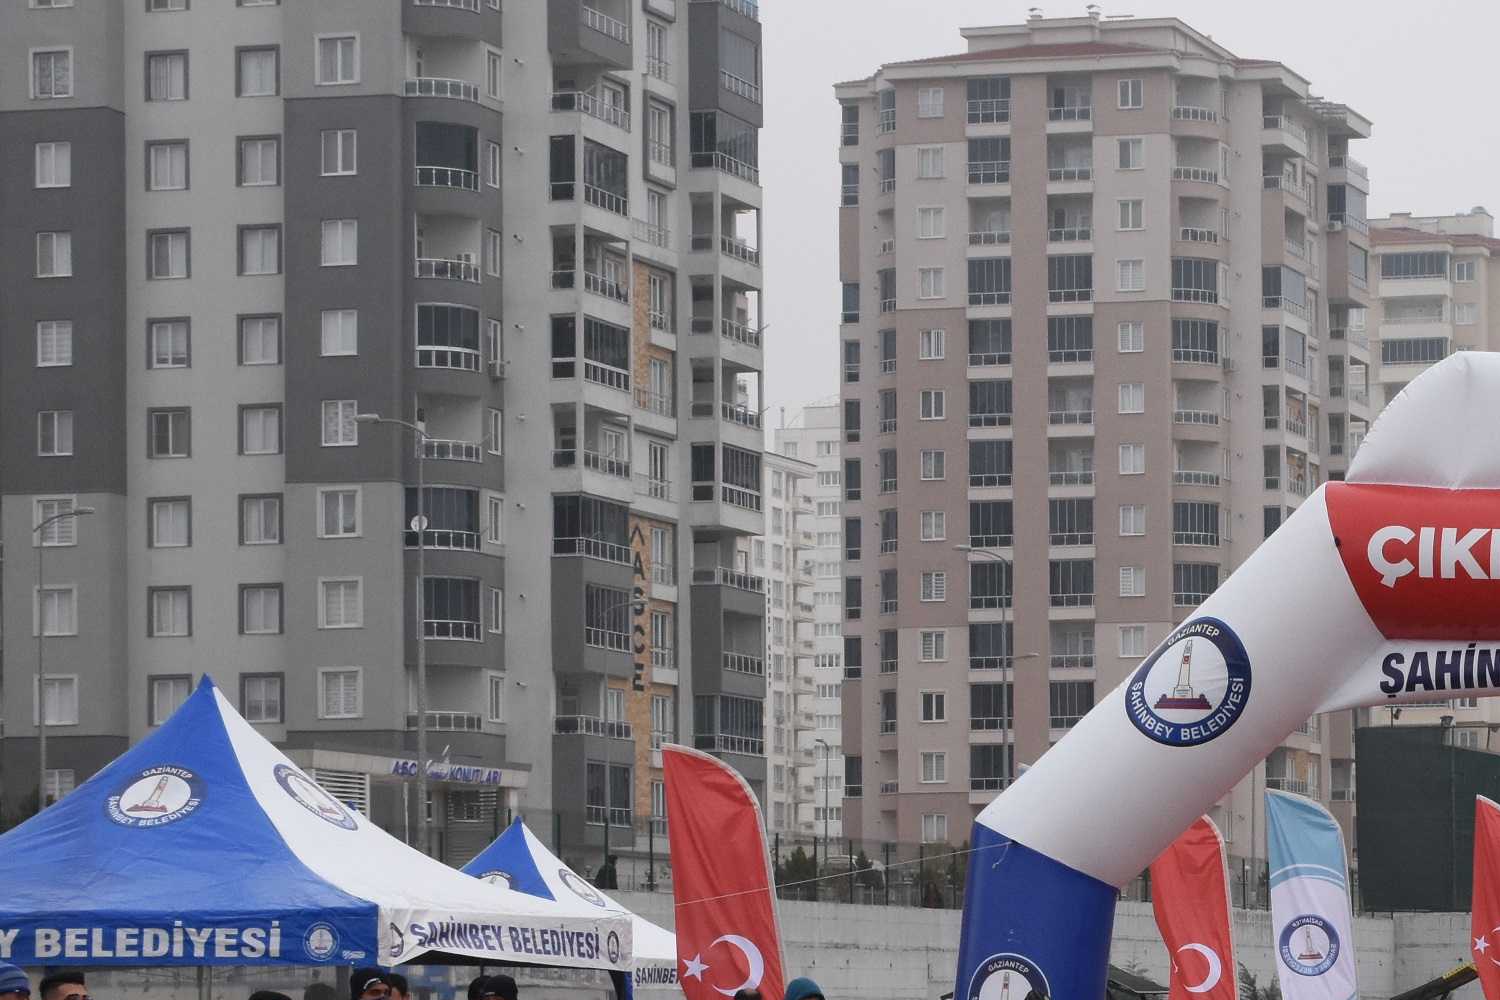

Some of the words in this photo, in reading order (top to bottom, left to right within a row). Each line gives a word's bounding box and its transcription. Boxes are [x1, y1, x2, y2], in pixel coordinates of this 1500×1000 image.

[1167, 624, 1220, 646] GAZİANTEP
[1131, 681, 1174, 739] ŞAHİNBEY
[1180, 677, 1244, 741] BELEDİYESİ
[142, 765, 193, 780] GAZİANTEP
[392, 760, 418, 777] ASC
[108, 795, 135, 827] ŞAHİNBEY
[138, 798, 201, 827] BELEDİYESİ
[35, 920, 281, 958] BELEDİYESİ
[509, 924, 600, 960] BELEDİYESİ
[987, 959, 1029, 974] GAZİANTEP
